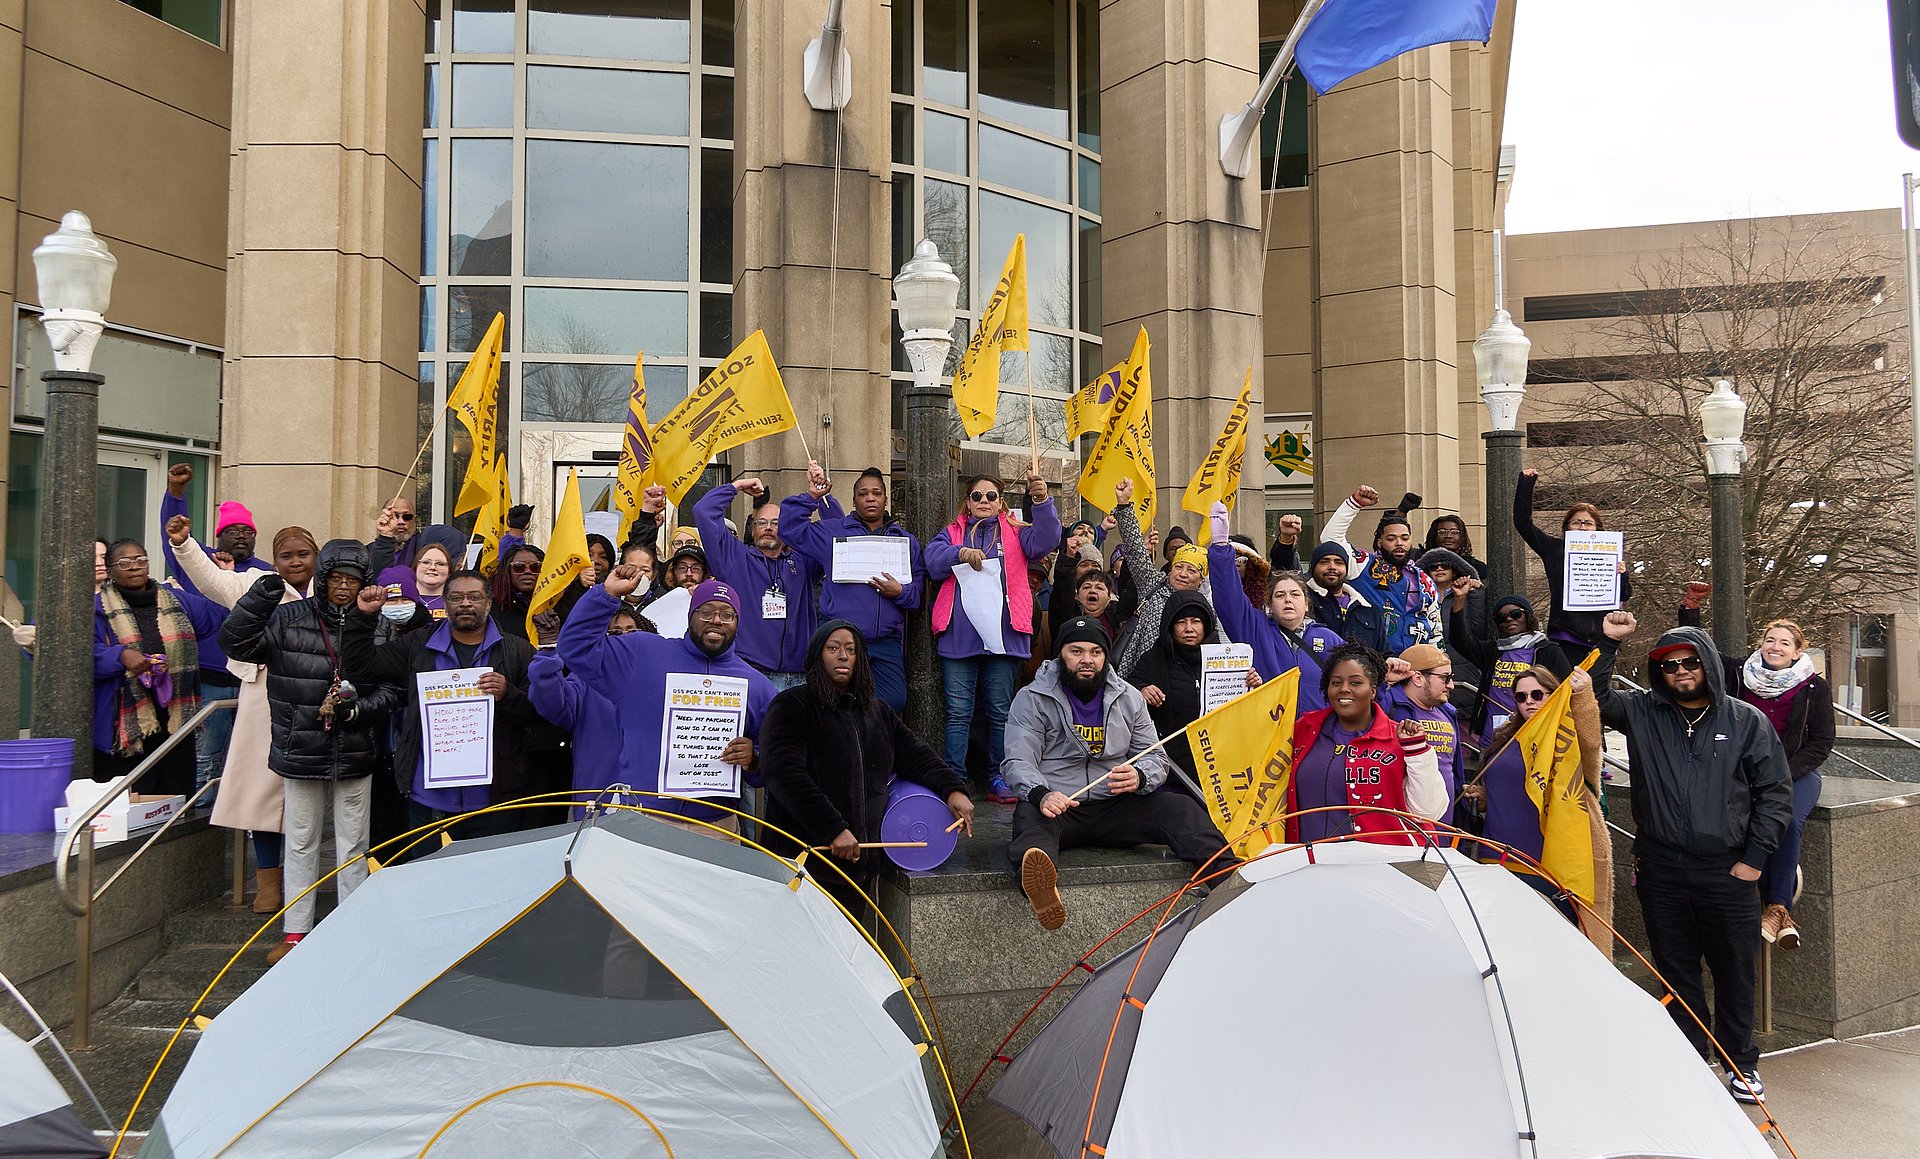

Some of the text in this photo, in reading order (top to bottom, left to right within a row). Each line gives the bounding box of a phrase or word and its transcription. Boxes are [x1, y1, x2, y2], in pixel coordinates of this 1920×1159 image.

[623, 488, 637, 509] For
[1206, 660, 1250, 668] FOR FREE
[425, 689, 453, 700] FOR
[672, 694, 741, 708] FOR FREE
[1198, 728, 1232, 824] SEIU Health
